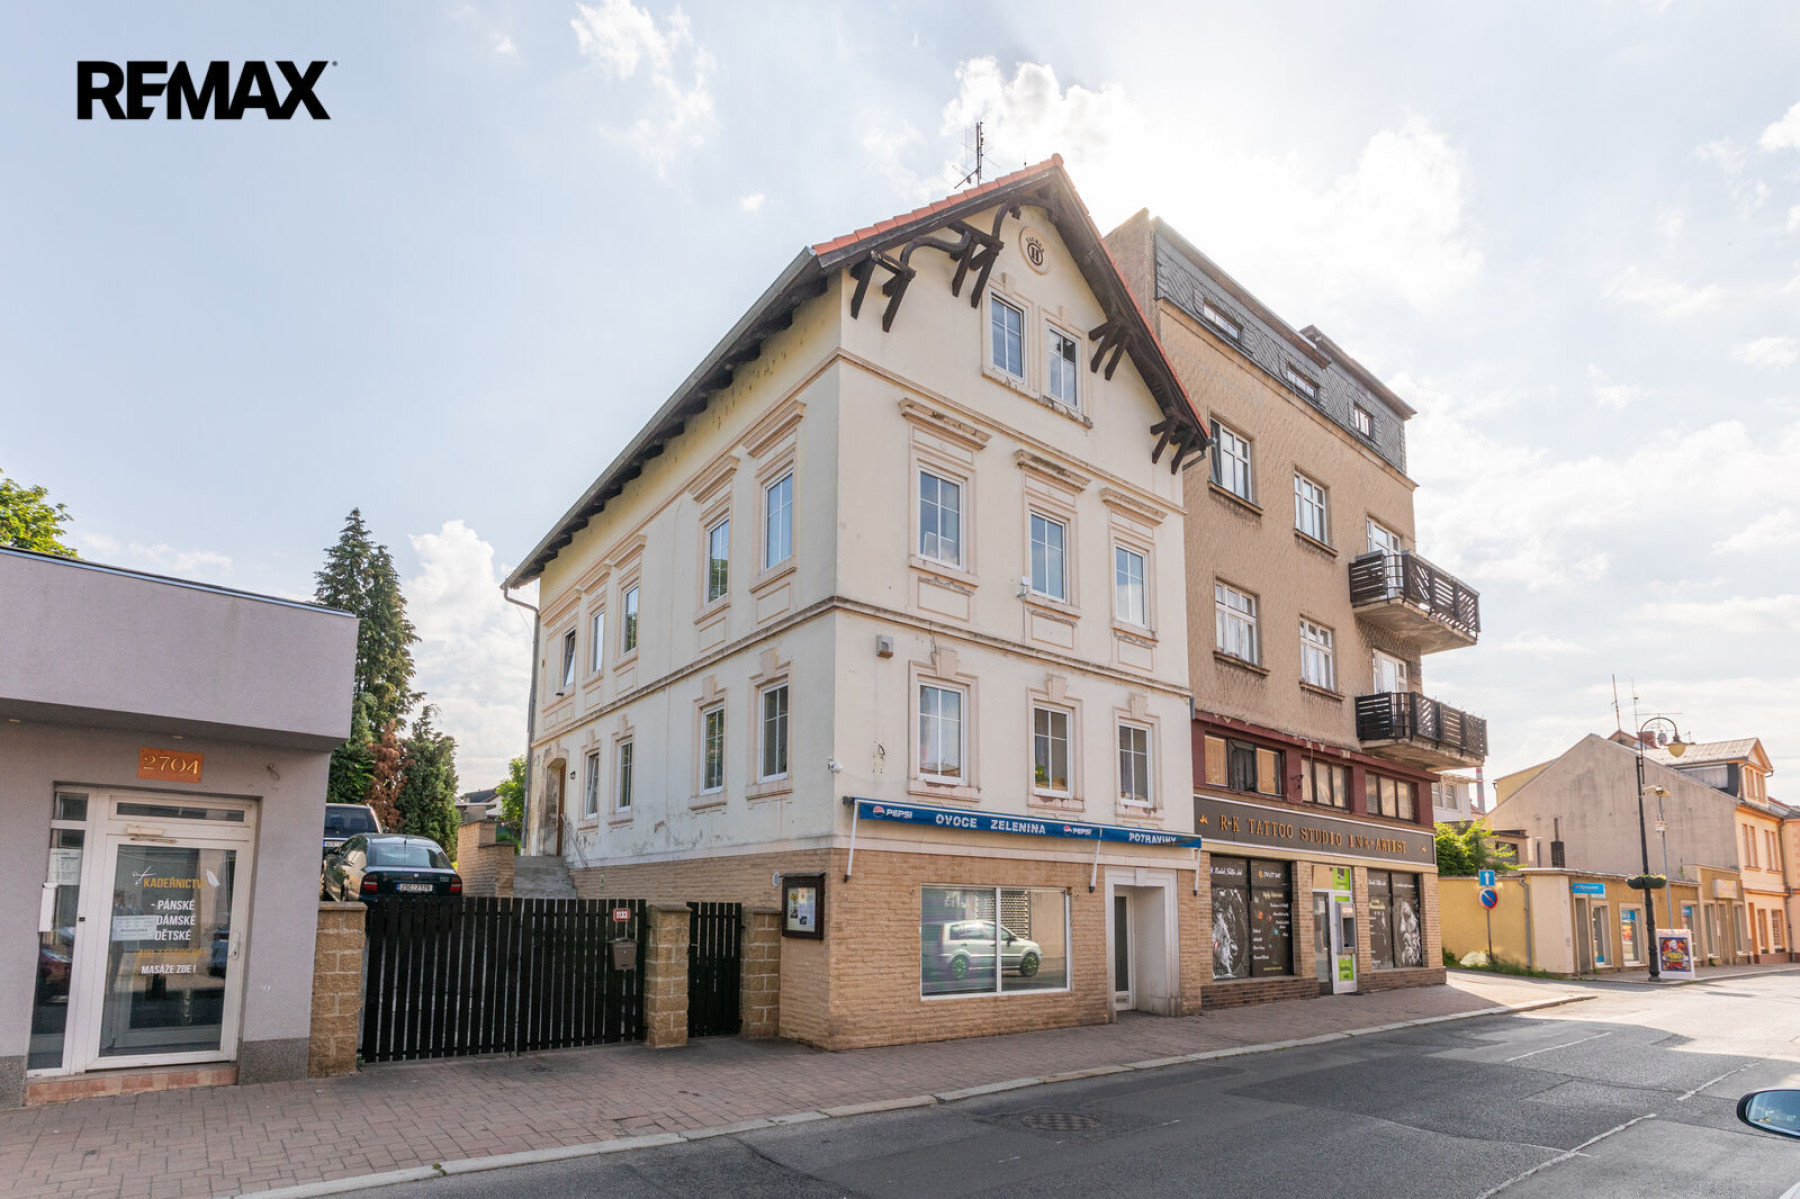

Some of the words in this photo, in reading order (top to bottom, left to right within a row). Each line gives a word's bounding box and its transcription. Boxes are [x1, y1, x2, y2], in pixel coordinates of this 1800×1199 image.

[143, 755, 199, 775] 2704
[885, 808, 913, 820] PEPSI
[935, 813, 978, 829] OVOCE
[990, 819, 1047, 834] ZELENINA
[1072, 827, 1092, 836] PEPSI
[1248, 818, 1294, 839] TATTOO
[1300, 828, 1342, 846] STUDIO
[157, 898, 197, 911] PÁNSKÉ
[156, 913, 197, 926] DÁMSKÉ
[154, 927, 192, 941] DĚTSKÉ
[141, 963, 174, 975] MASÁŽE
[175, 964, 192, 975] ZDE
